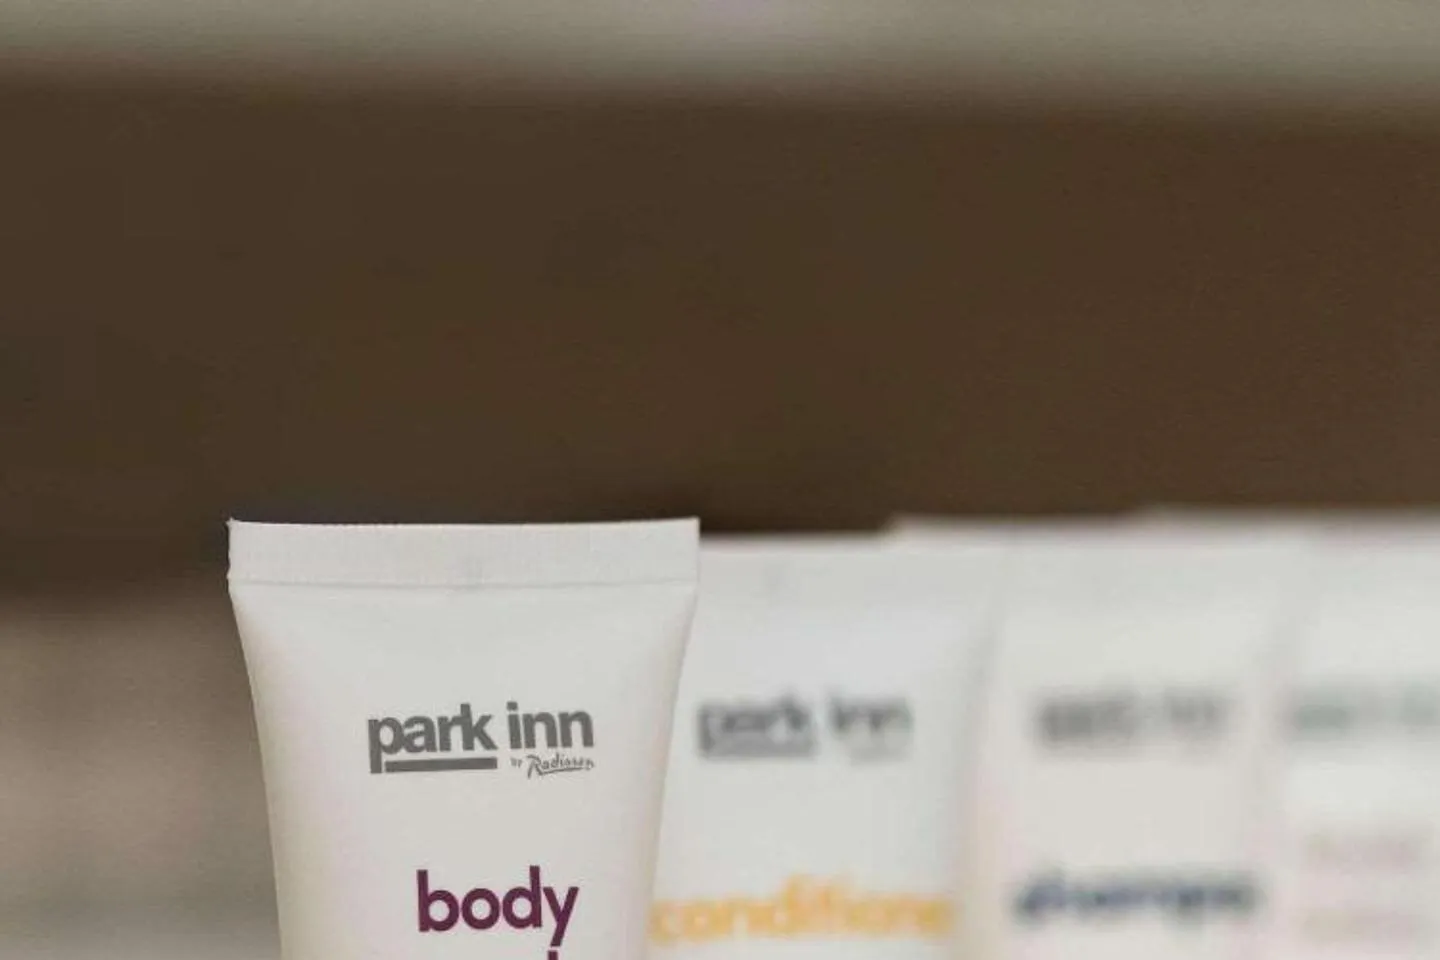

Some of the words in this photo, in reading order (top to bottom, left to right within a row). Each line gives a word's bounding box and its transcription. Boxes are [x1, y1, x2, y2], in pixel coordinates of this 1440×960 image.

[367, 703, 498, 774] park
[506, 701, 594, 749] inn
[416, 865, 579, 947] body
